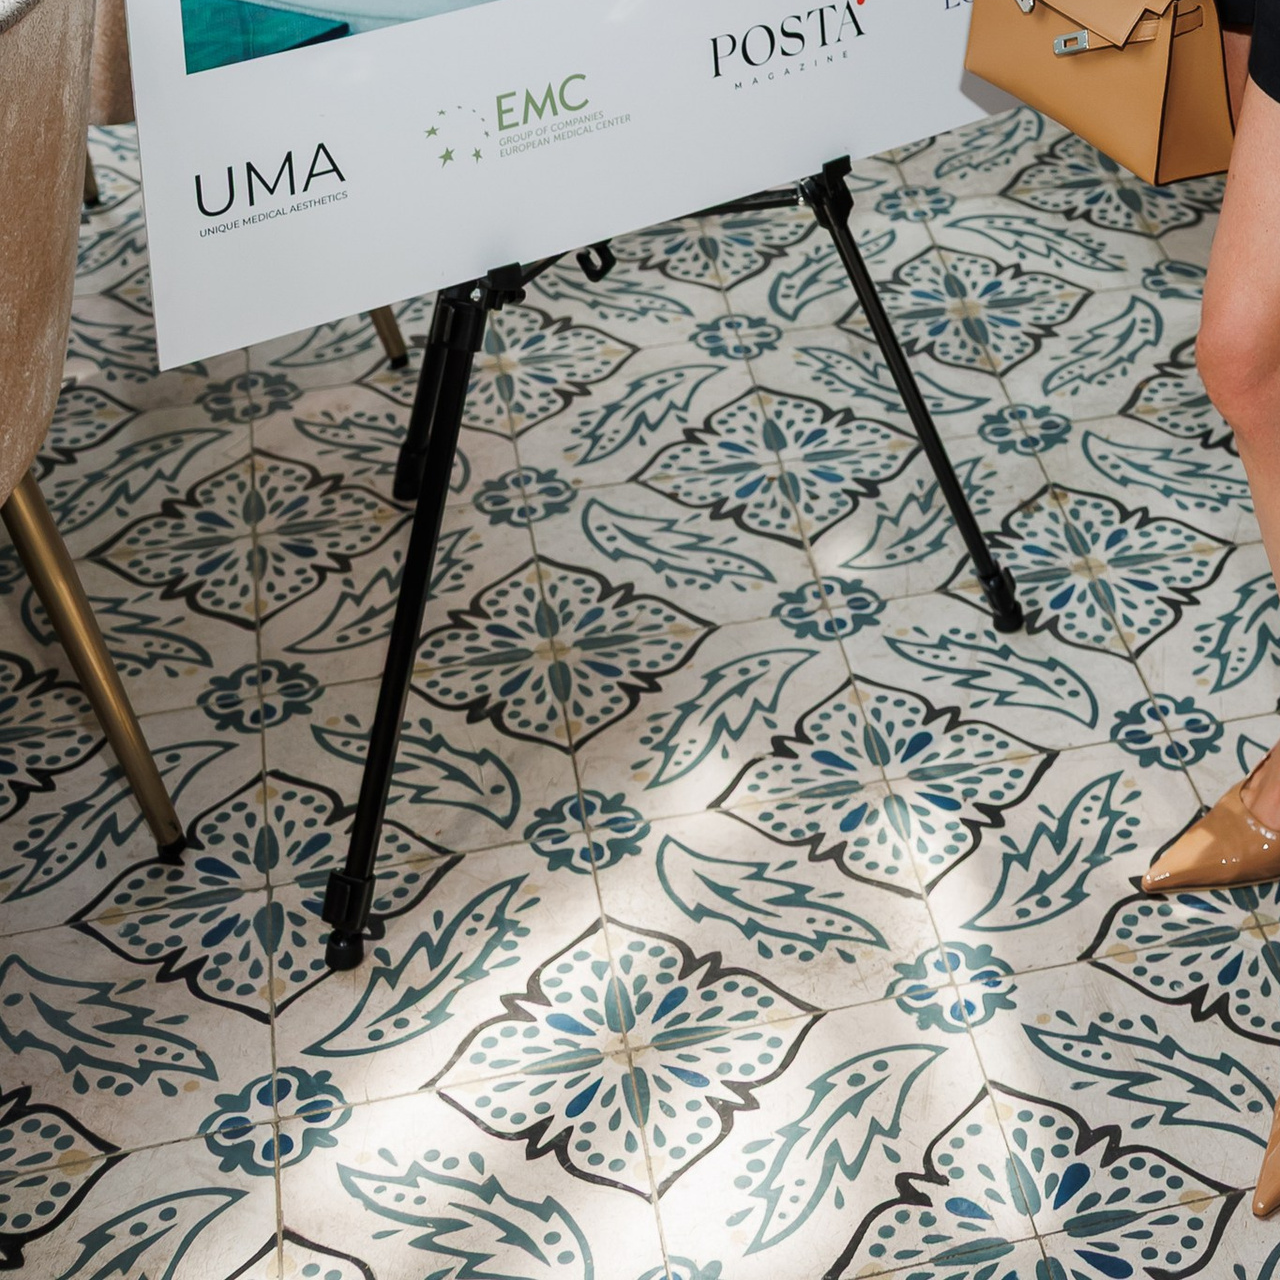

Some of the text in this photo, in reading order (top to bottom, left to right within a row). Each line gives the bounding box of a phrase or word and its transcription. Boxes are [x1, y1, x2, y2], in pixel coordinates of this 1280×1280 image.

[734, 49, 848, 90] MAGAZINE
[495, 73, 590, 132] EMC
[498, 110, 605, 147] GROUP OF COMPANIES
[499, 113, 632, 158] EUROPEAN MEDICAL CENTER
[194, 142, 347, 218] UMA
[199, 190, 349, 238] UNIQUE MEDICAL AESTHETICS
